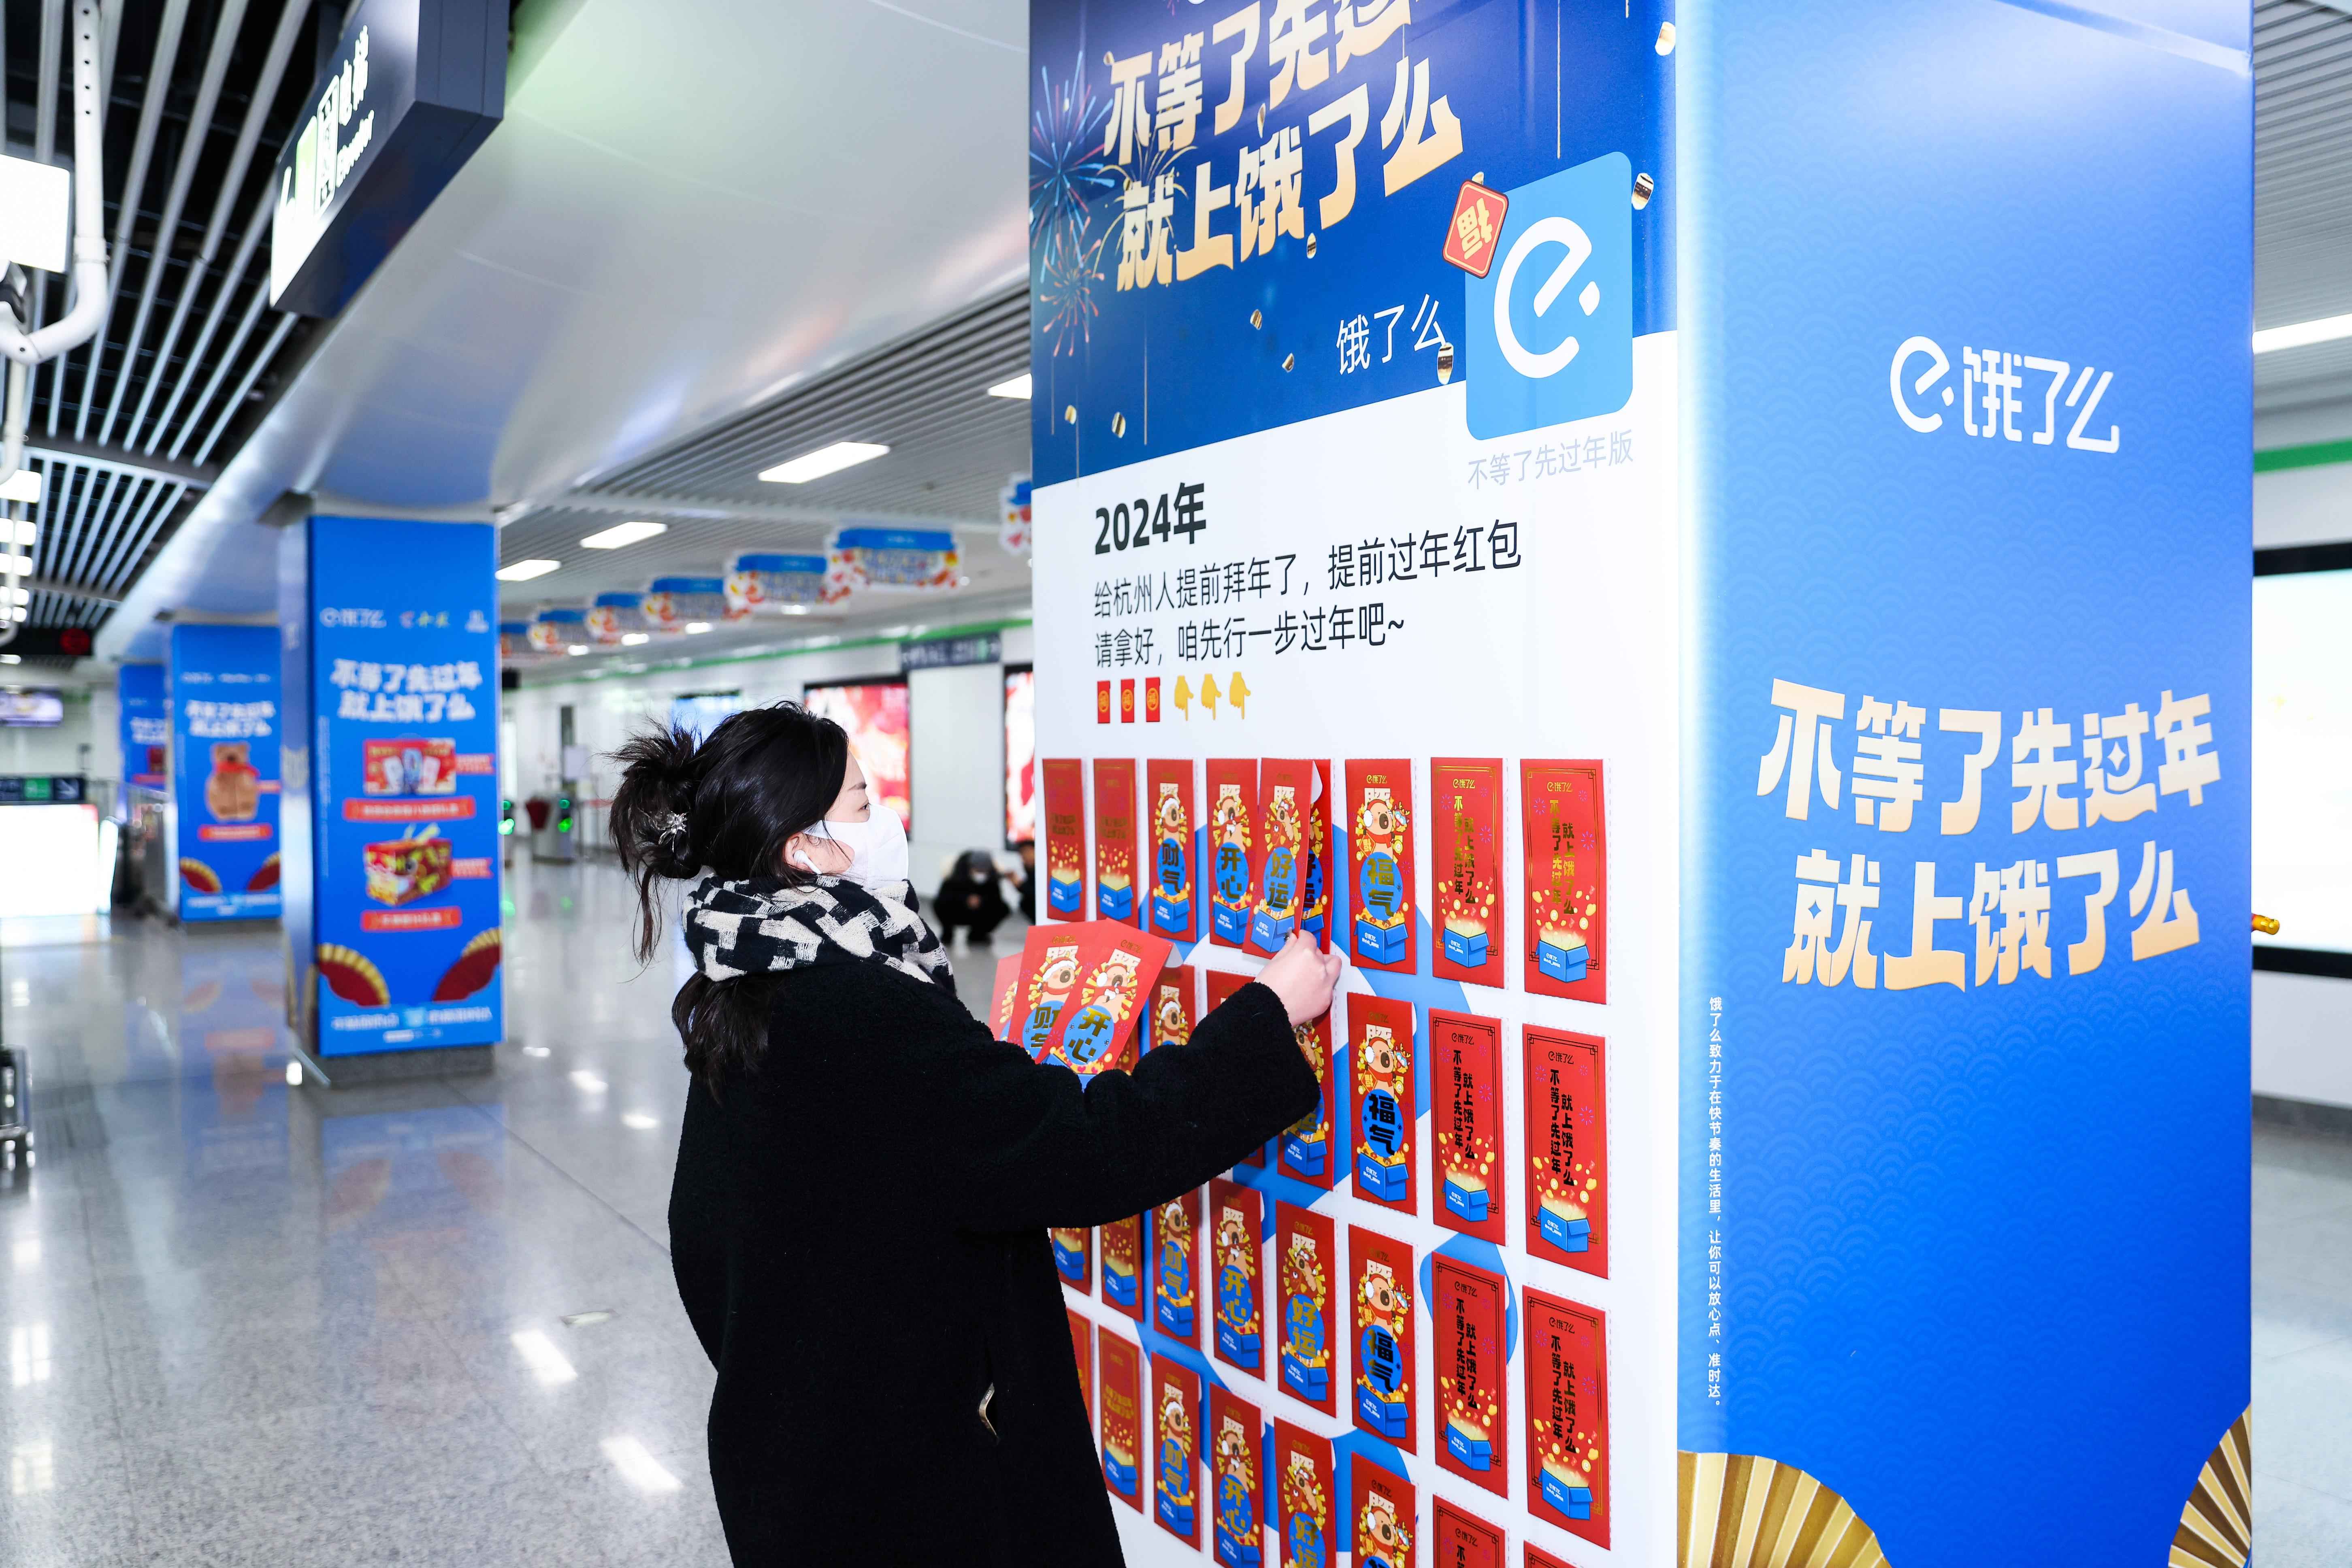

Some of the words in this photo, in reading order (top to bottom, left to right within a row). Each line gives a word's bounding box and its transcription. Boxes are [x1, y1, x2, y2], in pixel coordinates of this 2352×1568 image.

[1116, 55, 1464, 292] 就上饿了么
[1336, 294, 1446, 376] 饿了么
[1468, 429, 1633, 490] 不等了先过年版
[1095, 482, 1206, 555] 2024年
[1757, 678, 2221, 835] 不等了先过年
[1221, 847, 1241, 899] 开心
[1266, 852, 1292, 909] 好运
[1367, 858, 1395, 917] 福气
[1454, 795, 1464, 895] 不等了先过年
[1464, 817, 1476, 904] 就上饿了么
[1549, 799, 1562, 905] 不等了先过年
[1562, 823, 1574, 914] 就上饿了么
[1782, 840, 2200, 992] 就上饿了么
[1068, 1007, 1112, 1063] 开心
[1369, 1094, 1395, 1155] 福气
[1453, 1050, 1463, 1148] 不等了先过年
[1463, 1073, 1475, 1159] 就上饿了么
[1550, 1069, 1562, 1174] 不等了先过年
[1561, 1094, 1574, 1186] 就上饿了么
[1224, 1268, 1245, 1323] 开心
[1292, 1297, 1317, 1358] 好运
[1367, 1329, 1394, 1393] 福气
[1456, 1298, 1466, 1396] 不等了先过年
[1466, 1322, 1478, 1409] 就上饿了么
[1551, 1335, 1563, 1440] 不等了先过年
[1564, 1361, 1576, 1454] 就上饿了么
[1225, 1476, 1245, 1534] 开心
